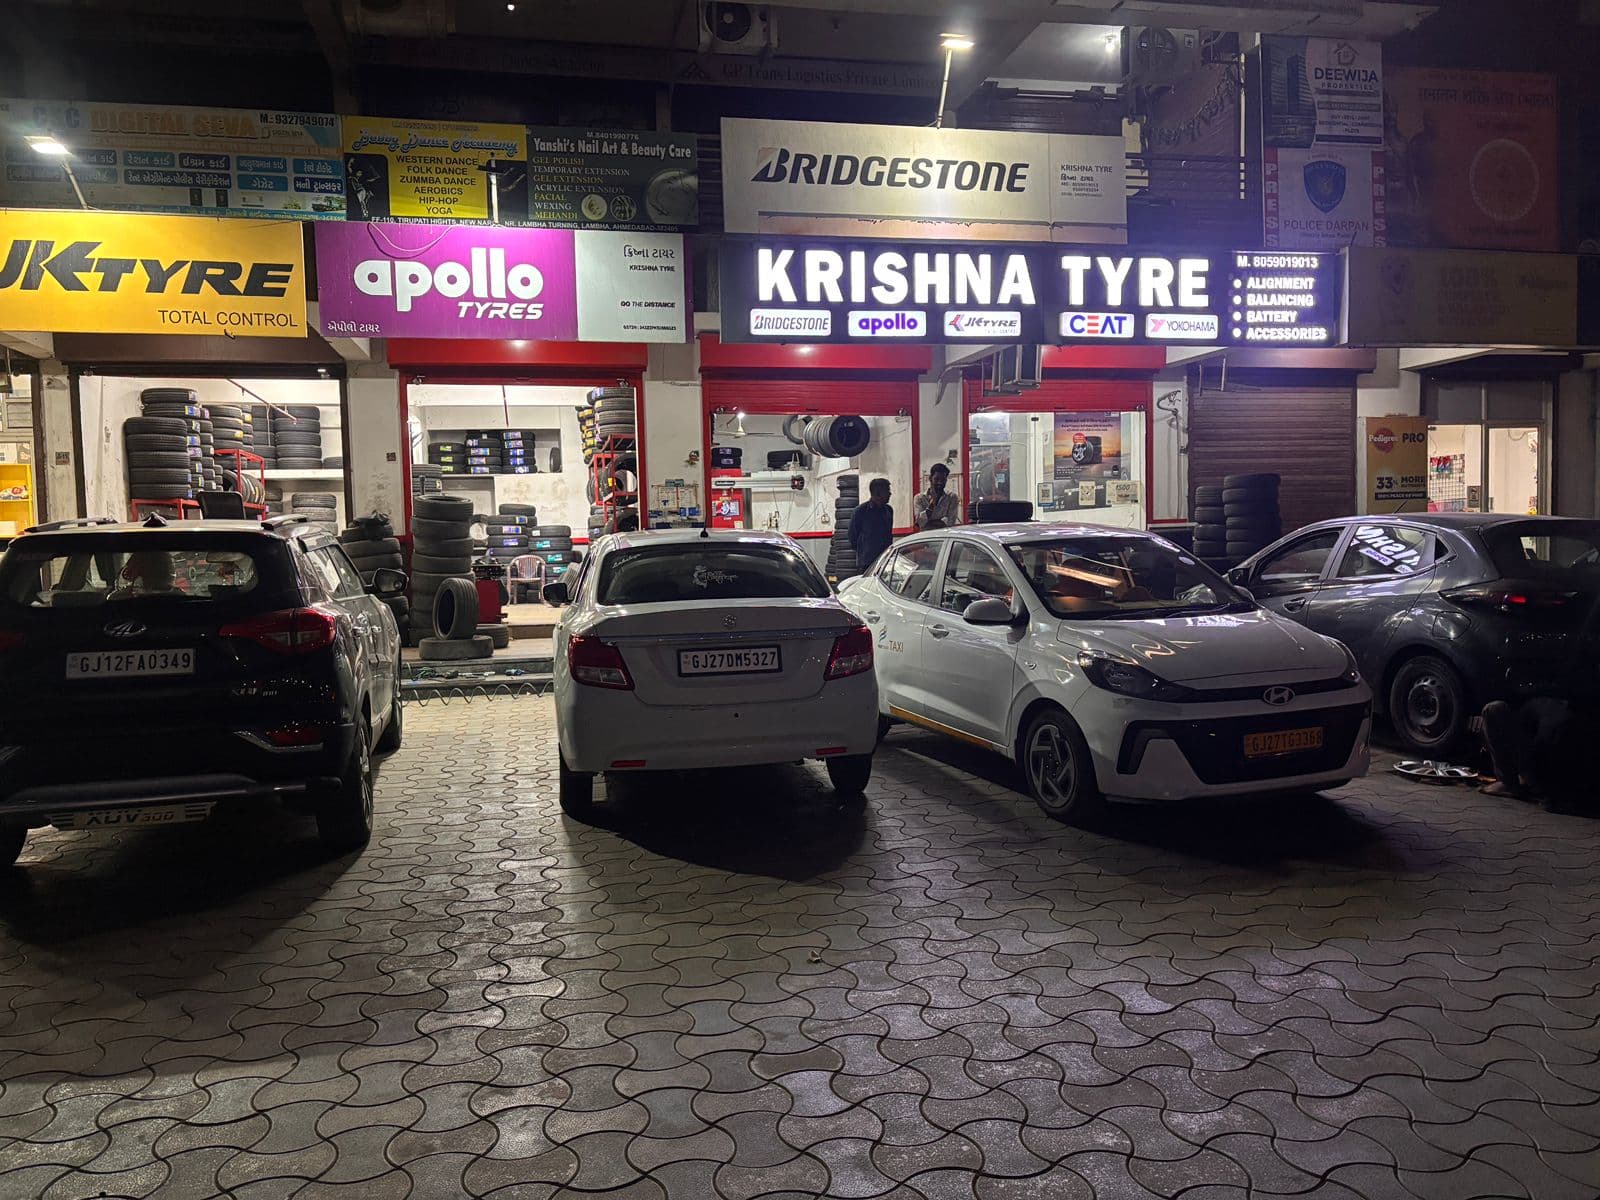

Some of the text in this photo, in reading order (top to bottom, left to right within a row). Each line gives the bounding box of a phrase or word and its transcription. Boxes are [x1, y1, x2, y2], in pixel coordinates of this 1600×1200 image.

[1314, 67, 1378, 82] DEEWIJA
[533, 138, 692, 160] Yanshi's Nail Art & Beauty Care
[396, 155, 478, 166] WESTERN DANCE
[532, 157, 550, 165] GEL
[407, 165, 468, 176] FOLK DANCE
[533, 166, 631, 176] TEMPORARY EXTENSION
[750, 147, 1029, 192] BRIDGESTONE
[1060, 164, 1112, 173] KRISHNA TYRE
[400, 175, 477, 186] ZUMMBA DANCE
[414, 186, 463, 196] AEROBICS
[534, 184, 573, 192] ACRYLIC
[419, 196, 458, 205] HIP-HOP
[534, 193, 567, 201] FACIAL
[426, 206, 453, 215] YOGA
[535, 202, 572, 210] WEXING
[535, 211, 578, 219] MEHANDI
[1283, 220, 1369, 231] POLICE DARPAN
[652, 248, 675, 259] ટાયર
[629, 264, 659, 272] KRISHNA
[1237, 255, 1319, 269] M. 8059019013
[353, 247, 544, 312] apollo
[758, 248, 1210, 307] KRISHNA TYRE
[1246, 277, 1315, 289] ALIGNMENT
[1246, 295, 1315, 306] BALANCING
[458, 301, 545, 320] TYRES
[158, 310, 298, 327] TOTAL CONTROL
[753, 314, 830, 331] BRIDGESTONE
[1246, 311, 1298, 323] BATTERY
[327, 320, 380, 334] એપોલો ટાયર
[857, 313, 919, 335] apollo
[1069, 315, 1127, 335] CEAT
[1166, 320, 1216, 333] YOKOHAMA
[1245, 327, 1328, 340] ACCESSORIES
[1402, 432, 1425, 443] PRO
[889, 640, 904, 654] TAXI
[80, 653, 191, 672] GJ12FA0349
[692, 651, 777, 669] GJ27DM5327
